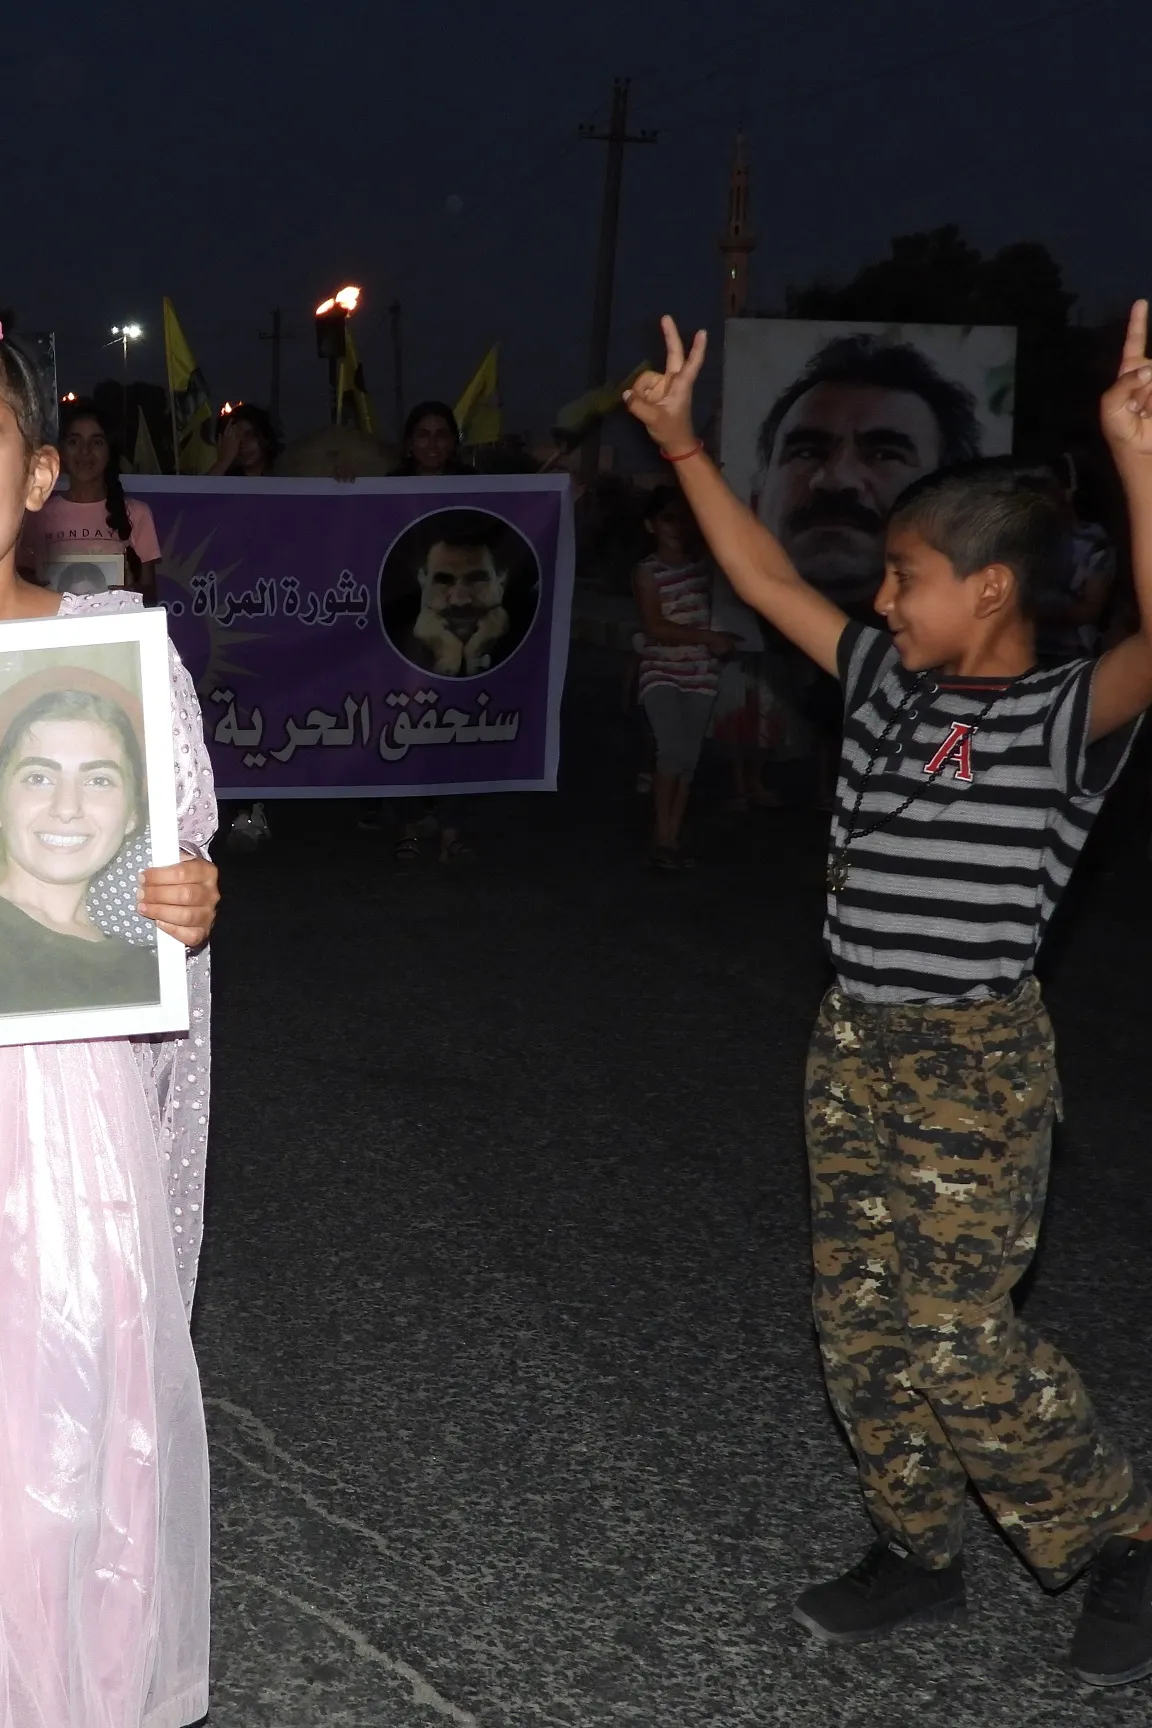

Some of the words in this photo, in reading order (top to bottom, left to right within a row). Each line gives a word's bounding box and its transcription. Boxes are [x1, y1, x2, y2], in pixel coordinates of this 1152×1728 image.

[191, 571, 277, 627] المرأة
[282, 569, 371, 629] بثورة
[211, 687, 371, 768] الحرية
[379, 688, 521, 763] سنحقق
[923, 721, 978, 782] A
